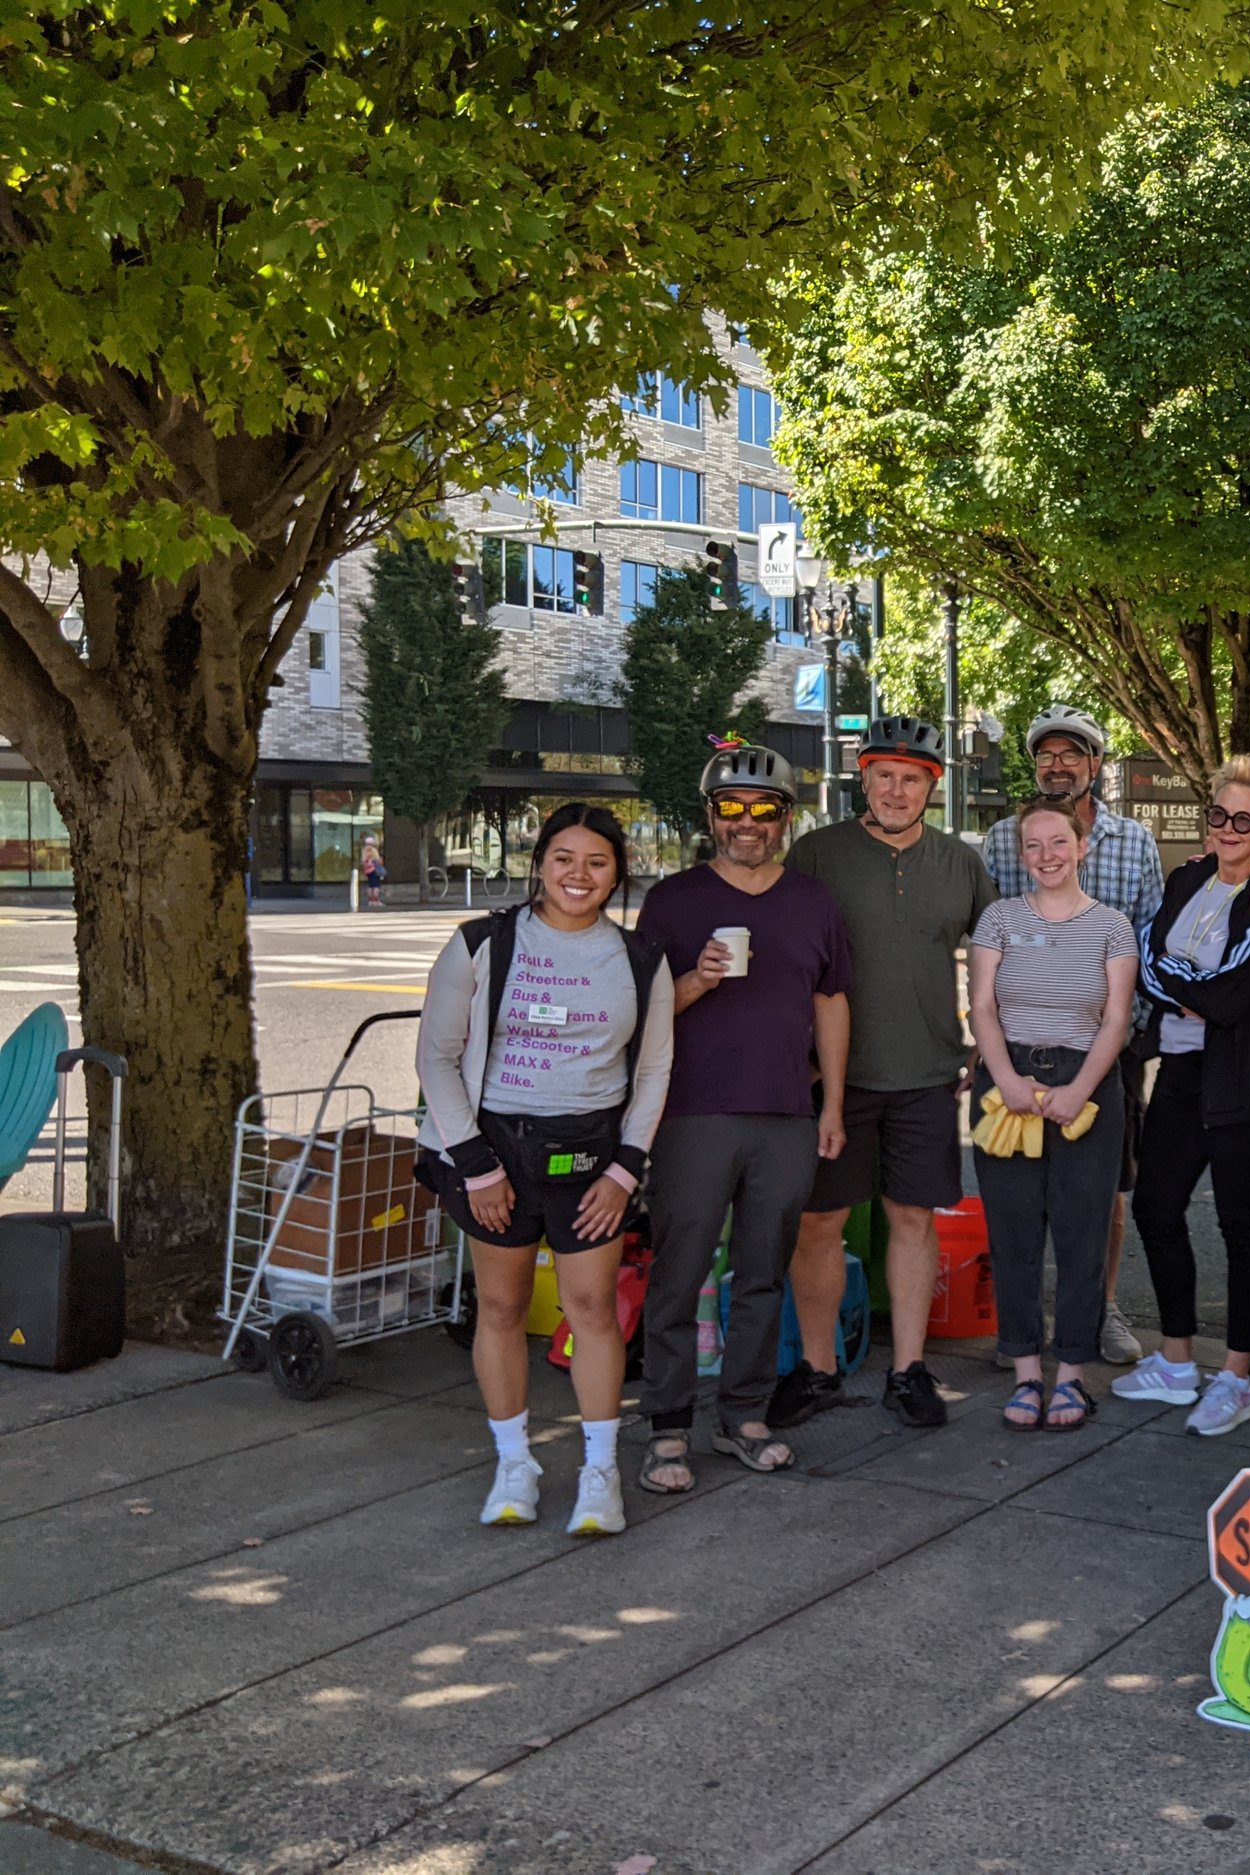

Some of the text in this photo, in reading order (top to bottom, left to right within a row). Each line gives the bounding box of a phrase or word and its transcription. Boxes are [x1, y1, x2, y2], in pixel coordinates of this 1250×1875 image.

[764, 562, 790, 574] ONLY
[1152, 774, 1187, 790] KeyBa
[1133, 803, 1200, 819] FOR LEASE
[517, 953, 554, 968] Roll &
[515, 970, 591, 986] Streetcar &
[511, 988, 552, 1004] Bus &
[567, 1011, 595, 1022] ram
[598, 1010, 609, 1023] &
[507, 1024, 559, 1038] Walk &
[506, 1036, 591, 1056] E-Scooter &
[504, 1052, 552, 1070] MAX &
[500, 1071, 535, 1088] Bike.
[574, 1152, 588, 1160] THE
